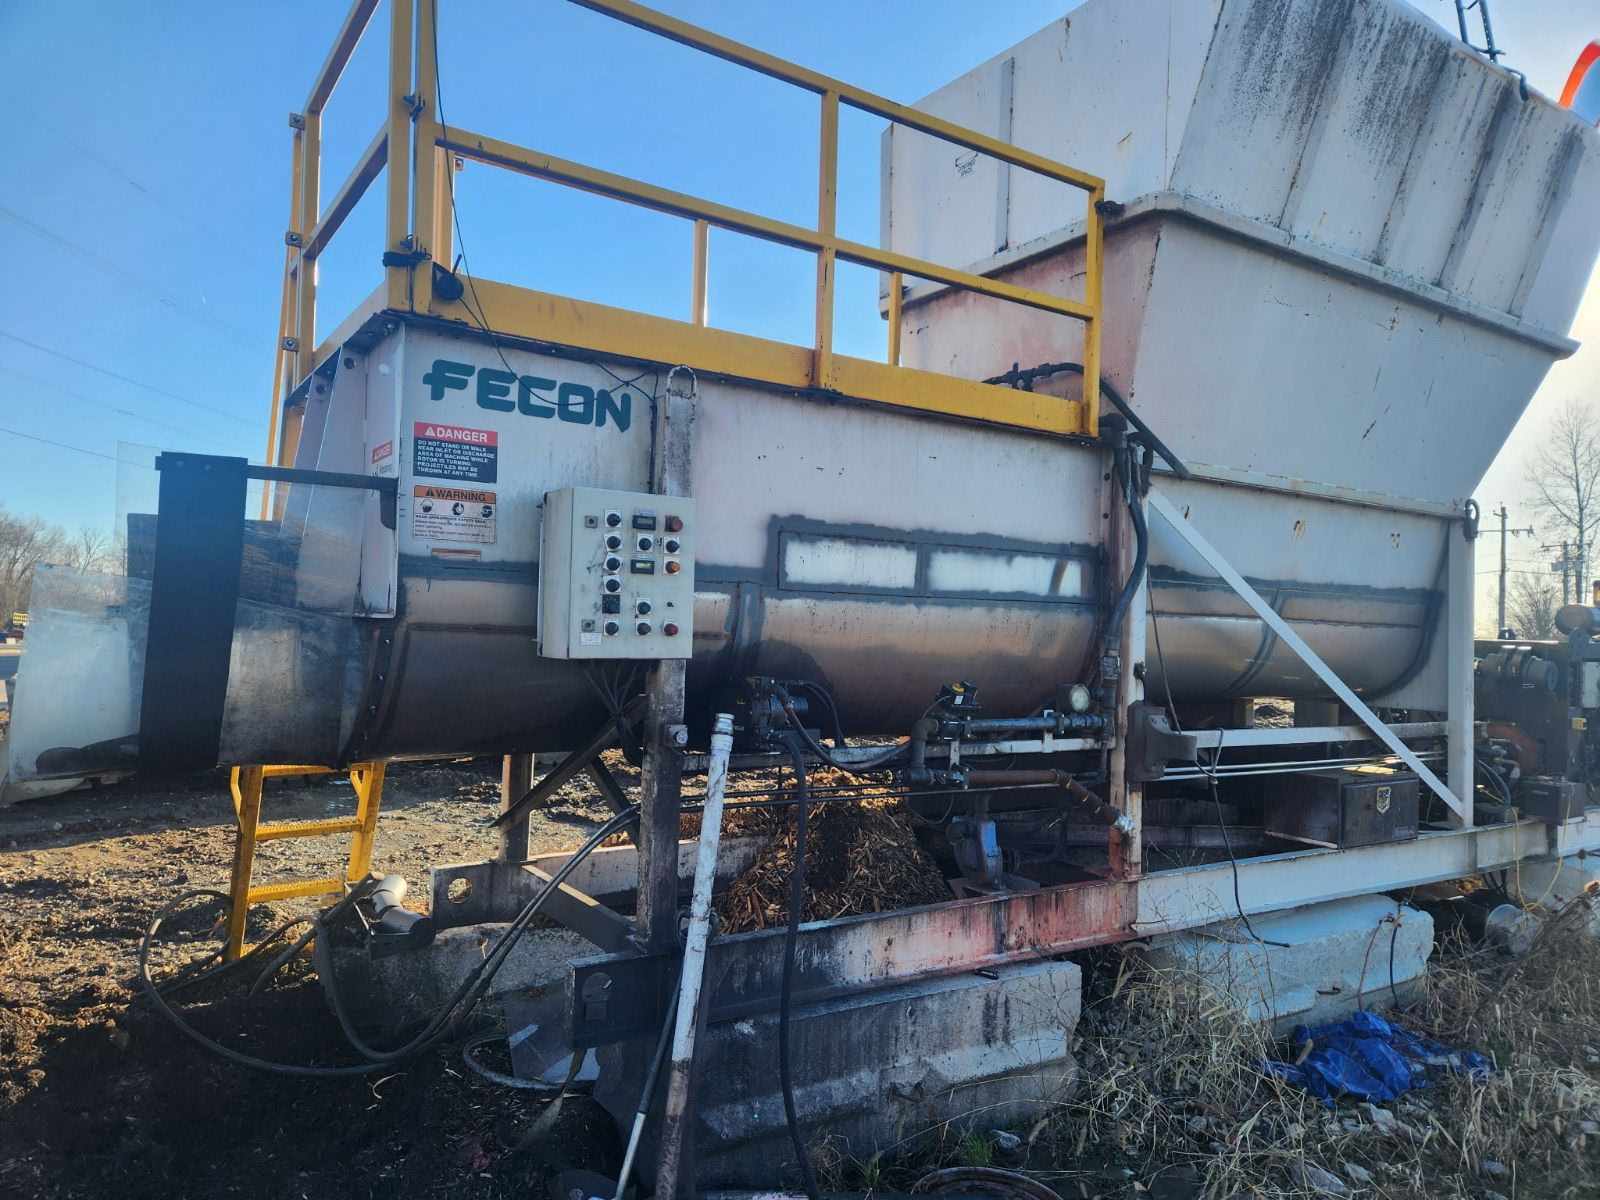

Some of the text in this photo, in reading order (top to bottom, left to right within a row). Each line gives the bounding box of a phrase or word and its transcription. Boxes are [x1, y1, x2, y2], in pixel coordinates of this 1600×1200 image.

[422, 359, 631, 433] FECON
[436, 427, 488, 442] DANGER
[462, 450, 495, 459] DISCHARGE
[417, 462, 456, 470] PROJECTILES
[436, 489, 486, 502] WARNING
